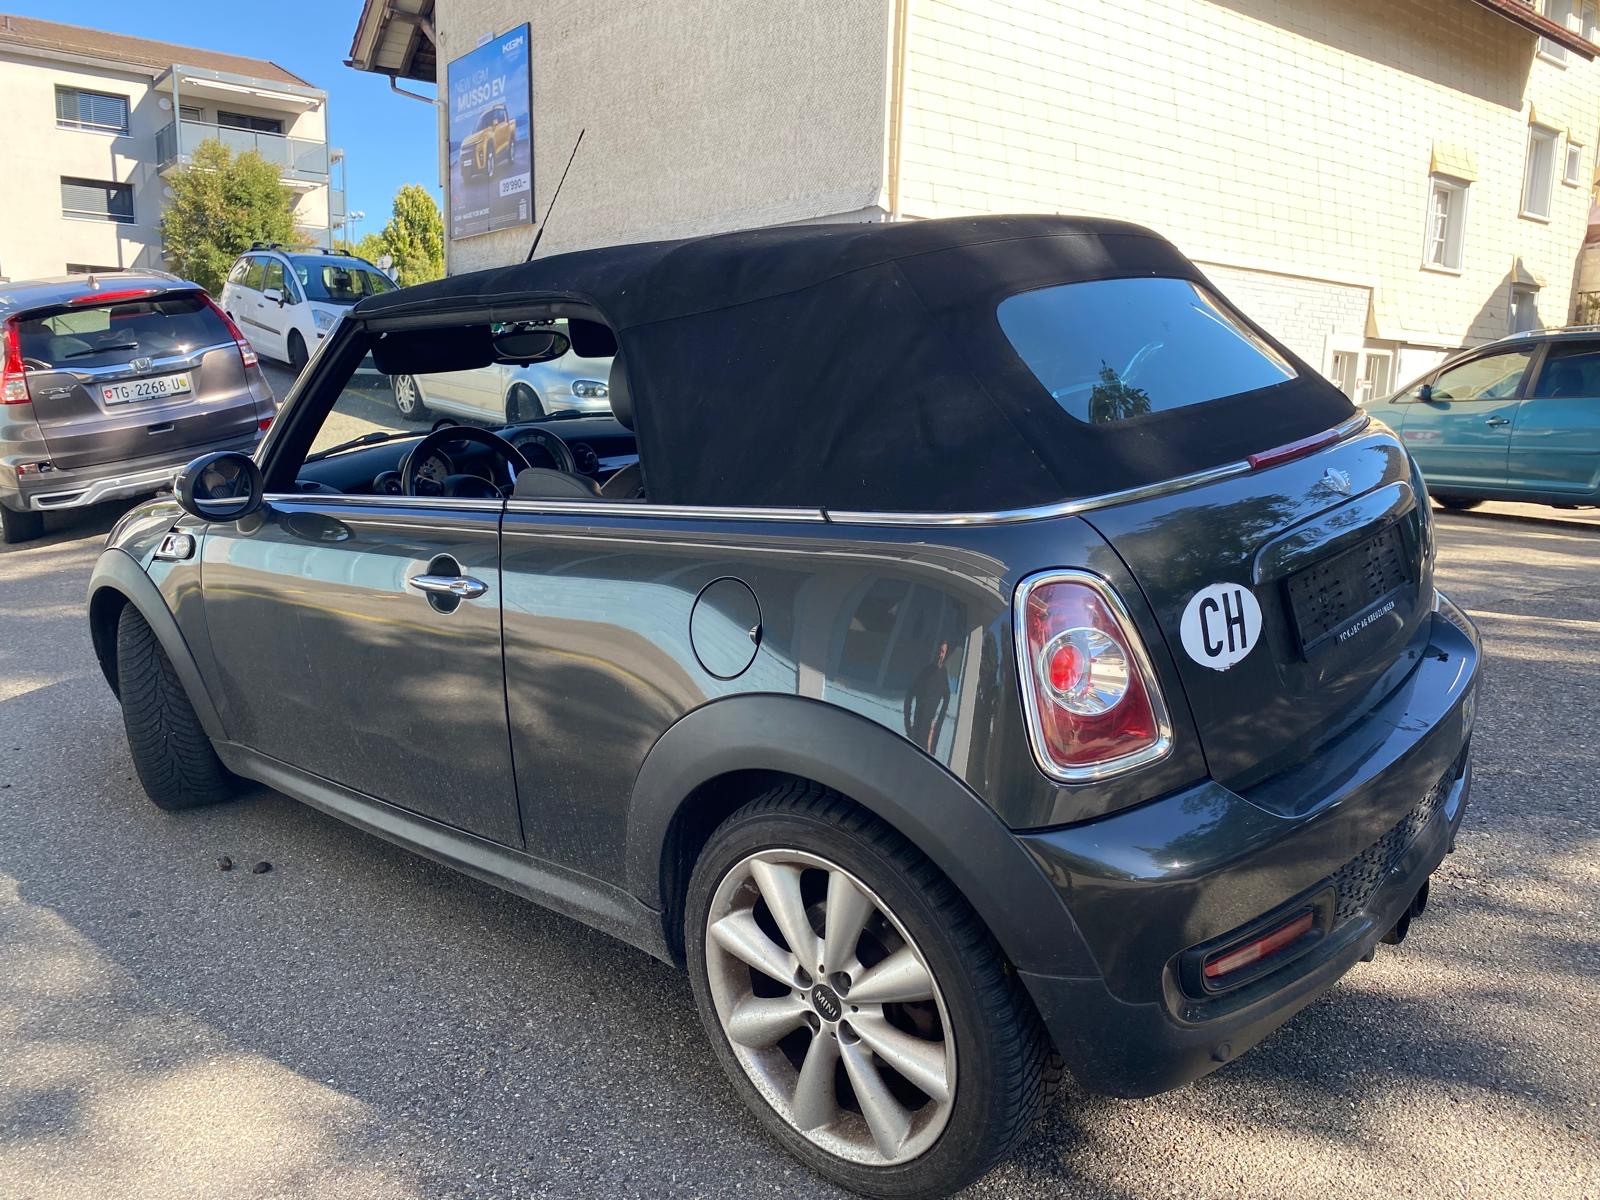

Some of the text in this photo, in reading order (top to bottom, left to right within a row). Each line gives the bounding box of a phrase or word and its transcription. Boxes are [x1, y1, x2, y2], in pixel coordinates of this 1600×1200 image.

[457, 82, 491, 113] MUSSO
[492, 74, 506, 97] EV
[1199, 590, 1247, 657] CH
[815, 990, 837, 1017] MINI
